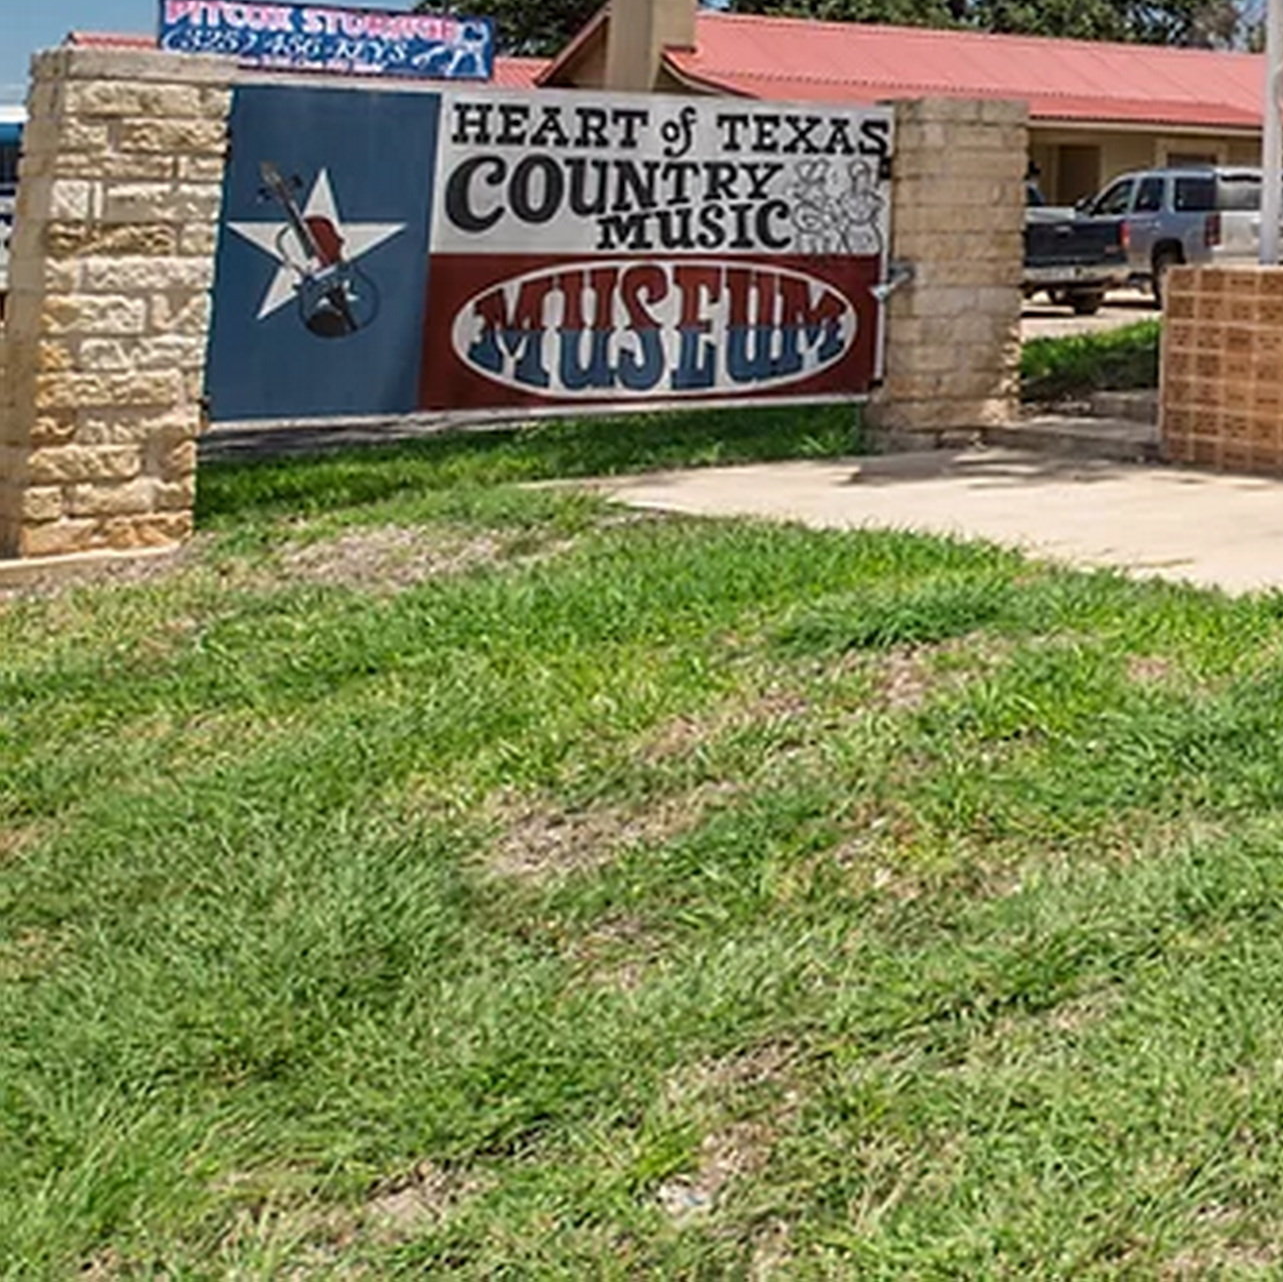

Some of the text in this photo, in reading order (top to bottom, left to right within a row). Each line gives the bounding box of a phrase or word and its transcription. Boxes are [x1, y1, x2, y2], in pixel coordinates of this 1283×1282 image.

[161, 27, 257, 53] (325)
[451, 103, 889, 157] HEART of TEXAS
[445, 154, 783, 233] COUNTRY
[597, 200, 792, 250] MUSIC
[467, 264, 847, 391] MUSEUM
